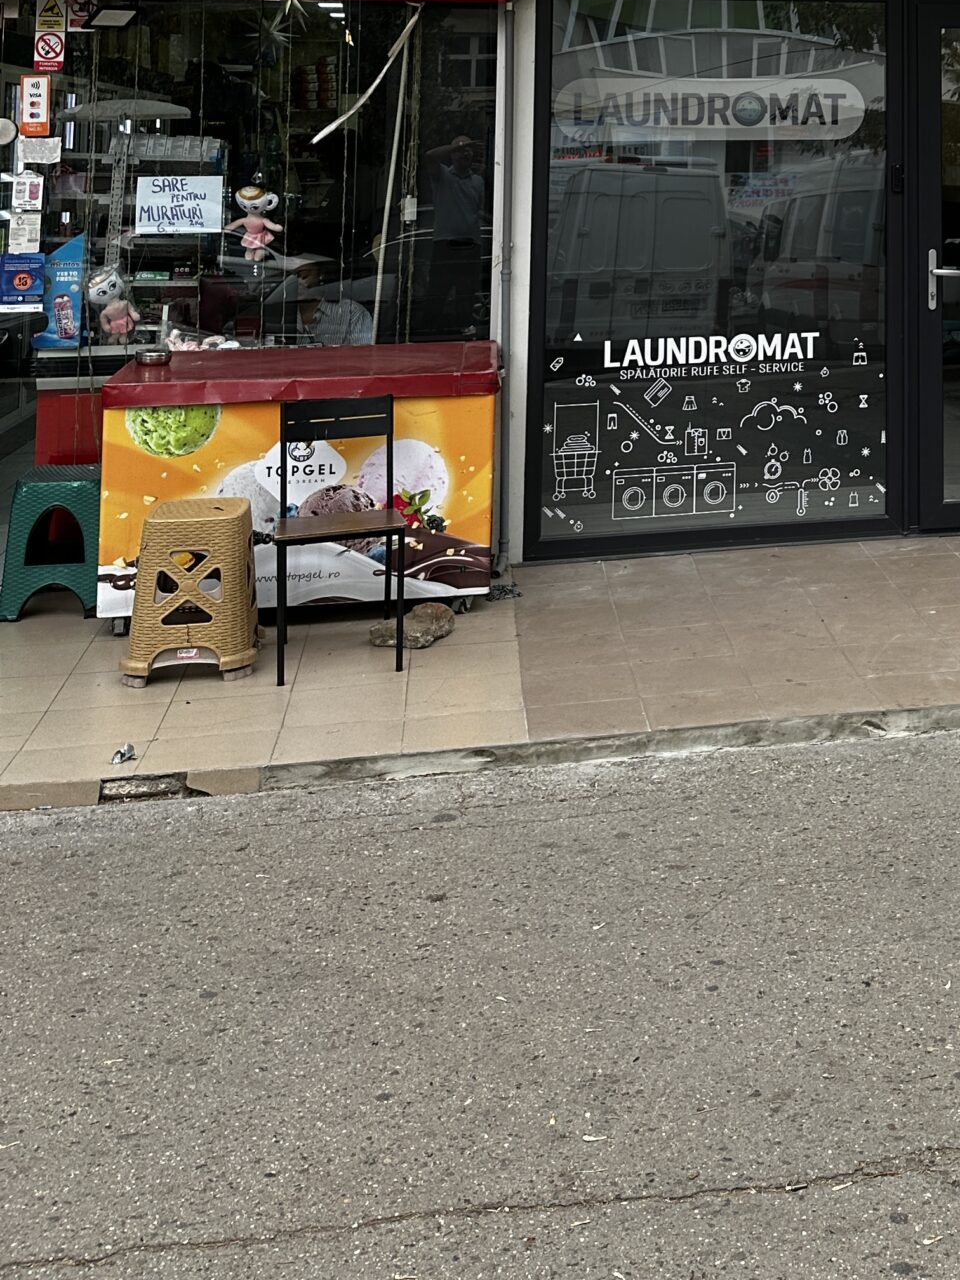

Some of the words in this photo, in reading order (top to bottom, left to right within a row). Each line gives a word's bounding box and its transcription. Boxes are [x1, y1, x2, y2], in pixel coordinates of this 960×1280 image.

[573, 92, 847, 127] LAUNDROMAT
[152, 178, 188, 193] SARE
[170, 192, 206, 203] PENTRU
[604, 332, 820, 368] LAUNDROMAT
[619, 366, 688, 380] SPĂLĂTORIE
[691, 365, 720, 376] RUFE
[722, 364, 748, 375] SELF
[758, 362, 805, 373] SERVICE
